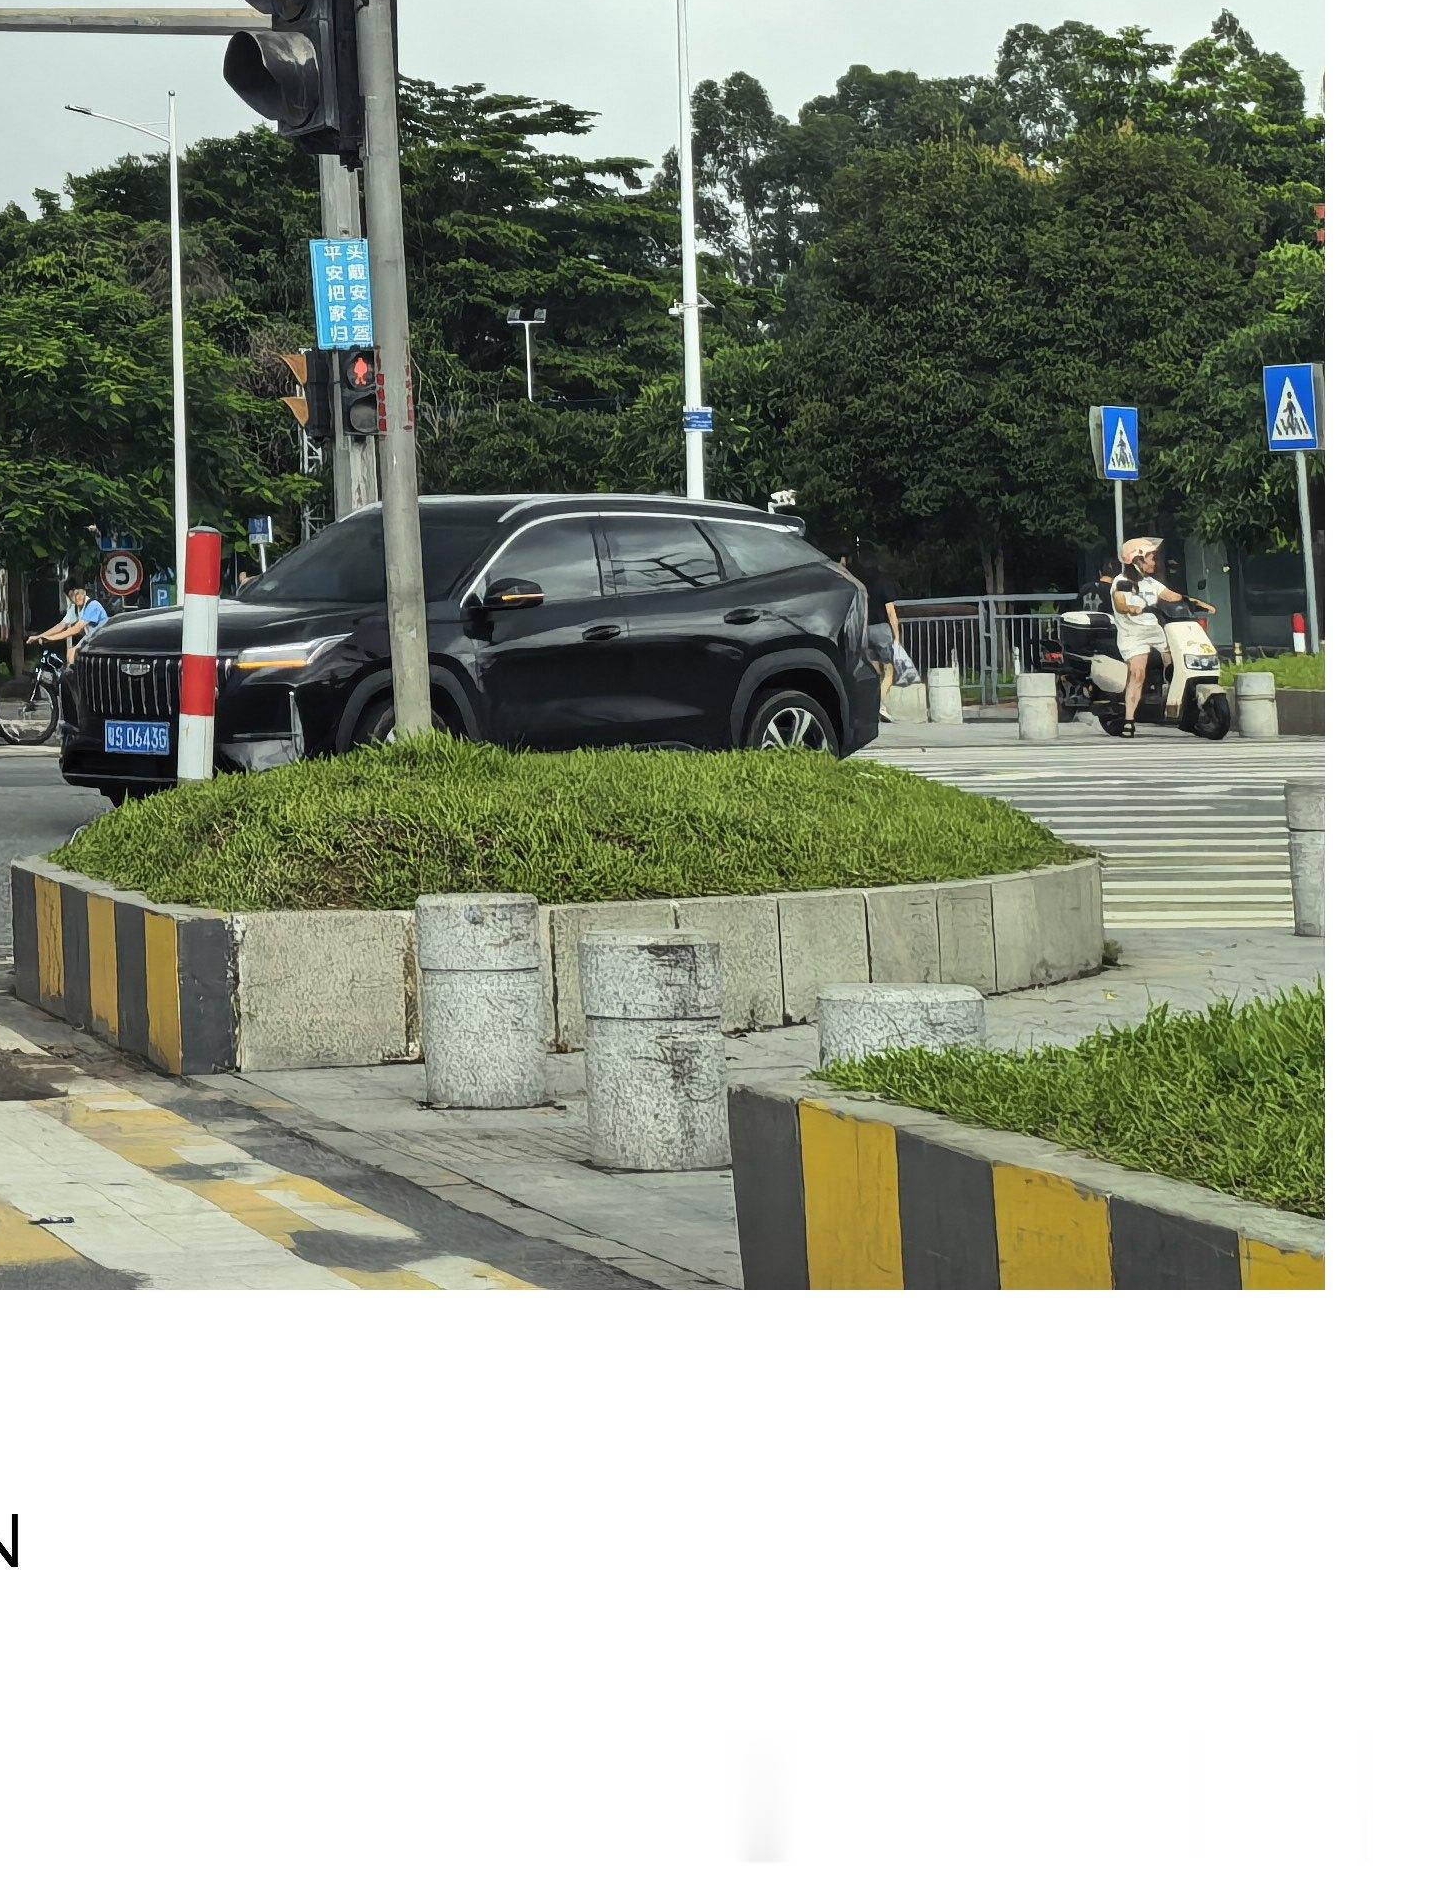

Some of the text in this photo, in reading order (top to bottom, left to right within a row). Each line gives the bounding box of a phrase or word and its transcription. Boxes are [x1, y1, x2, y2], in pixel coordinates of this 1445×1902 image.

[324, 245, 348, 342] 平安把家归
[346, 244, 371, 341] 头戴安全盔
[115, 561, 130, 585] 5
[157, 589, 168, 606] P
